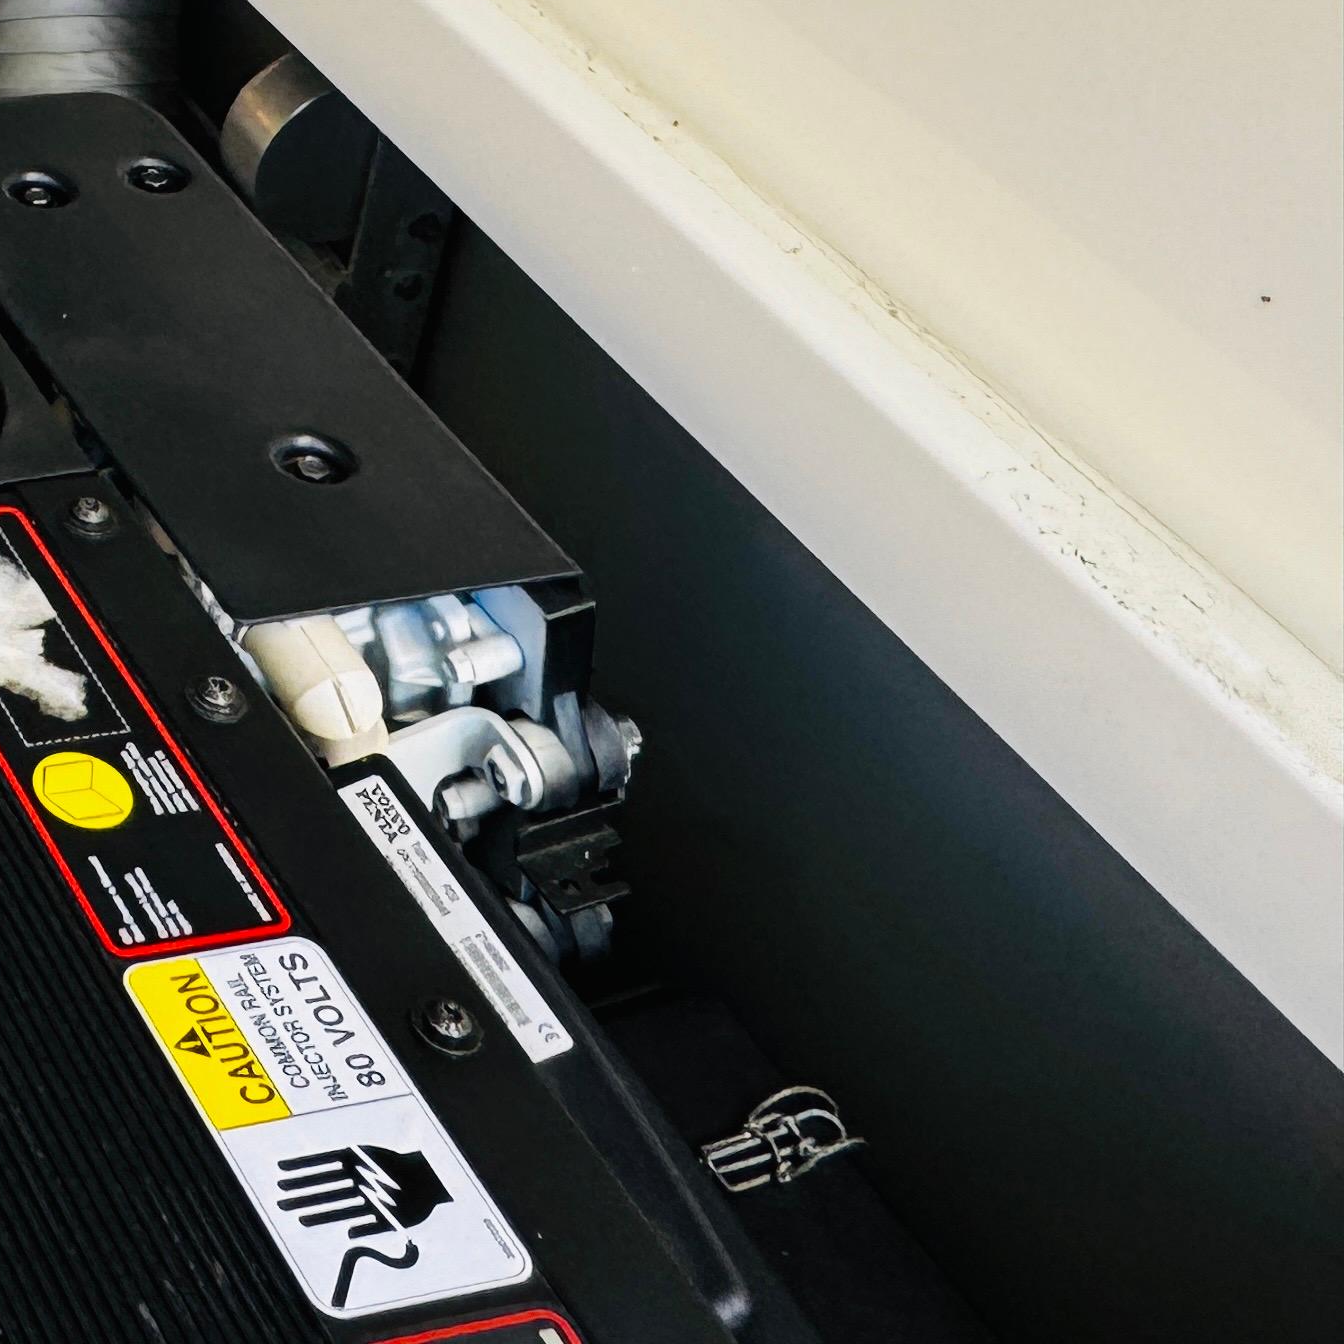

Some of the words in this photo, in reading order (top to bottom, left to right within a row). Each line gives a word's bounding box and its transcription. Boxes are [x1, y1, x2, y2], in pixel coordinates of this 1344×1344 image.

[226, 972, 261, 1012] RAIL
[239, 953, 294, 1017] SYSTEM
[278, 953, 356, 1048] VOLTS
[170, 972, 275, 1104] CAUTION
[249, 1013, 310, 1088] COMMON
[282, 1019, 349, 1102] INJECTOR
[345, 1053, 386, 1088] 80
